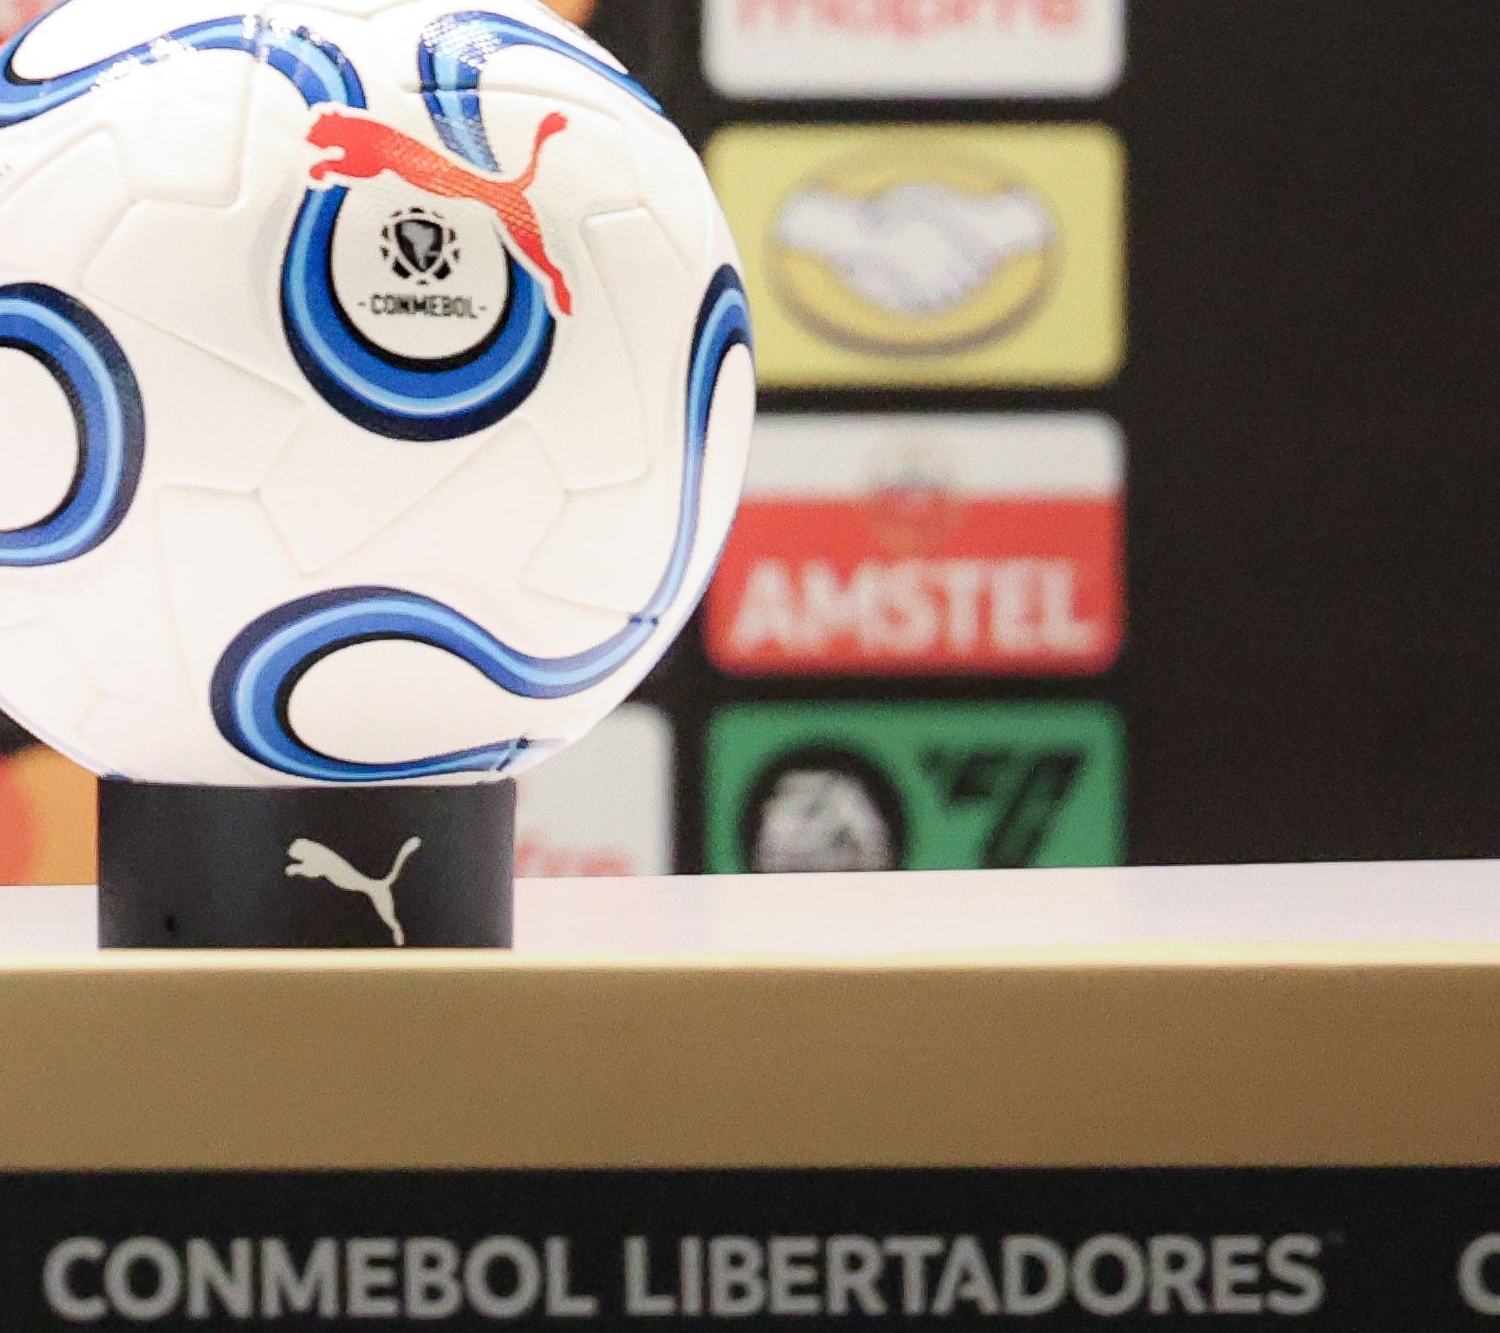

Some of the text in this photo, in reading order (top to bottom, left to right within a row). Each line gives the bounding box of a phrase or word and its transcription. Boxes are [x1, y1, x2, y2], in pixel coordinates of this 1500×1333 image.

[730, 558, 1094, 652] AMSTEL
[43, 1233, 1324, 1321] CONMEBOL LIBERTADORES
